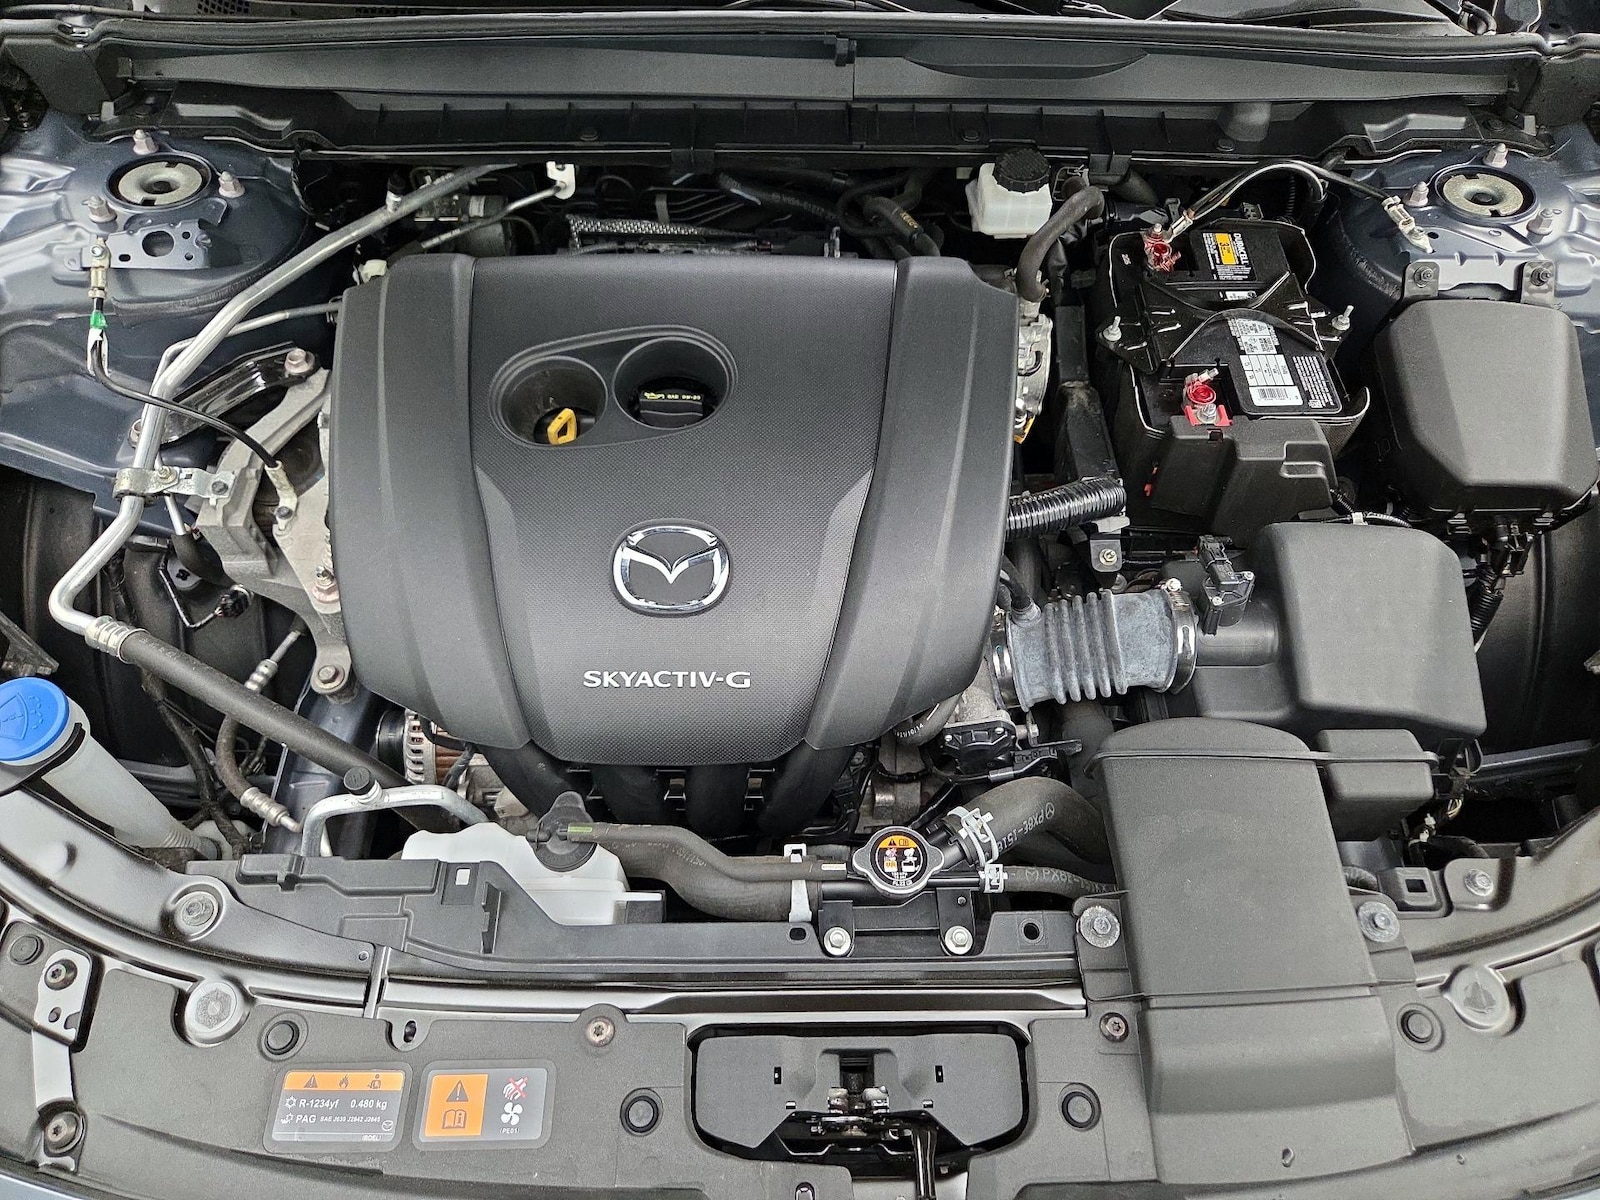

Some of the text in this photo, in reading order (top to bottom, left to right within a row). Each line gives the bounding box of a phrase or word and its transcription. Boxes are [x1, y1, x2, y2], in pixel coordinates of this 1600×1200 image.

[1233, 232, 1249, 266] DURACELL
[583, 670, 751, 689] SKYACTIV-G
[299, 1099, 388, 1111] R-1234yf 0.480 kg
[295, 1114, 317, 1124] PAG
